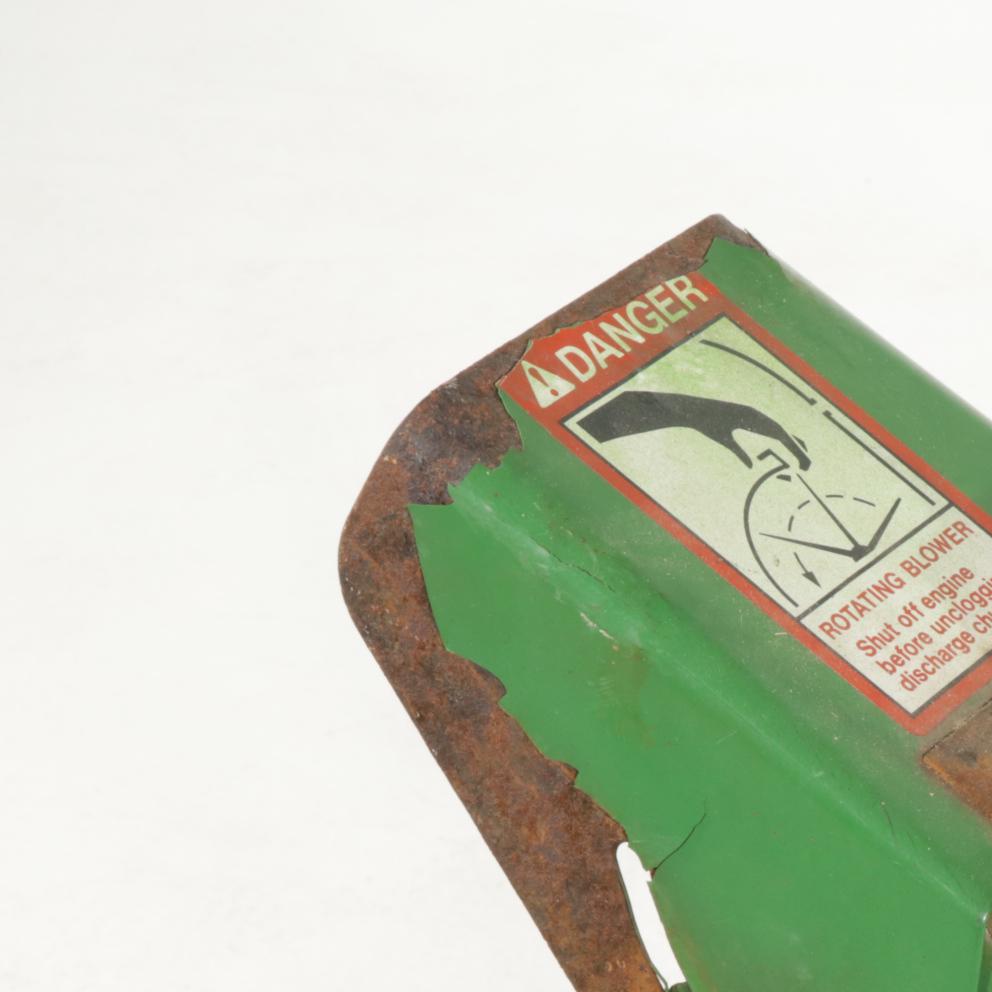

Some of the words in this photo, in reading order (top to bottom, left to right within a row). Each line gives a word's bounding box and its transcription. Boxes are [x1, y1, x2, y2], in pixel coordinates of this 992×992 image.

[554, 275, 708, 383] DANGER
[819, 572, 906, 639] ROTATING
[900, 521, 975, 577] BLOWER
[856, 622, 901, 657] Shut
[897, 602, 924, 627] off
[922, 567, 975, 609] engine
[877, 631, 934, 675] before
[900, 629, 976, 692] discharge
